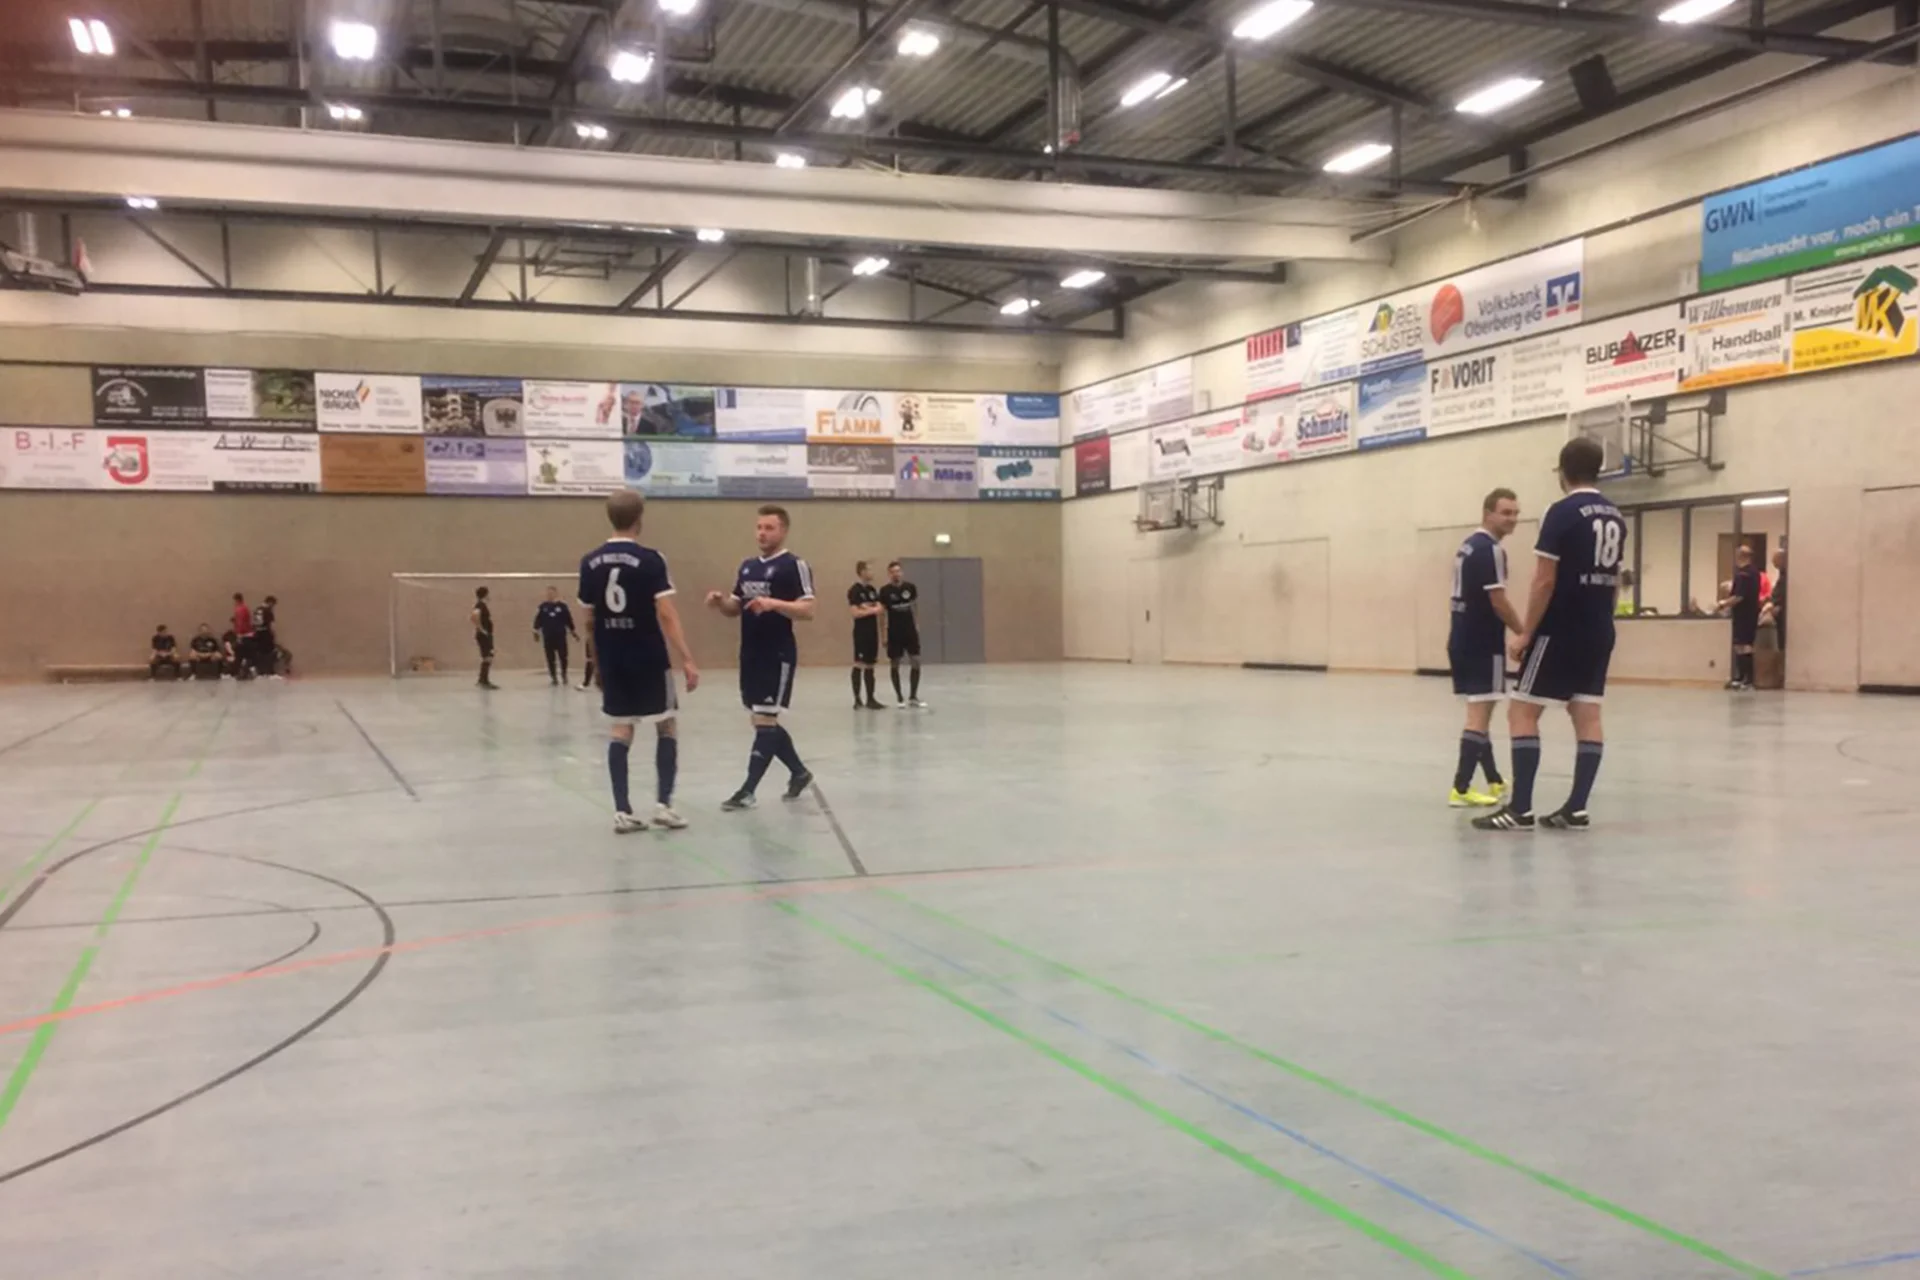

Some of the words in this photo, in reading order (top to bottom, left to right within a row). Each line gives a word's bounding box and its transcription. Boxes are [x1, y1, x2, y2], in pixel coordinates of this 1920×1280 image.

[1705, 200, 1756, 234] GWN
[1477, 286, 1543, 318] Volksbank
[1687, 294, 1783, 325] Willkommen
[1463, 310, 1523, 339] Oberberg
[1524, 307, 1543, 326] eG
[1712, 325, 1782, 351] Handball
[1361, 326, 1424, 359] SCHUSTER
[1586, 328, 1677, 365] BUBENZER
[1431, 356, 1497, 395] FAVORIT
[816, 410, 882, 434] FLAMM
[1296, 410, 1349, 440] Schmidt
[933, 468, 974, 482] Mies
[1592, 518, 1621, 569] 18
[605, 568, 626, 613] 6
